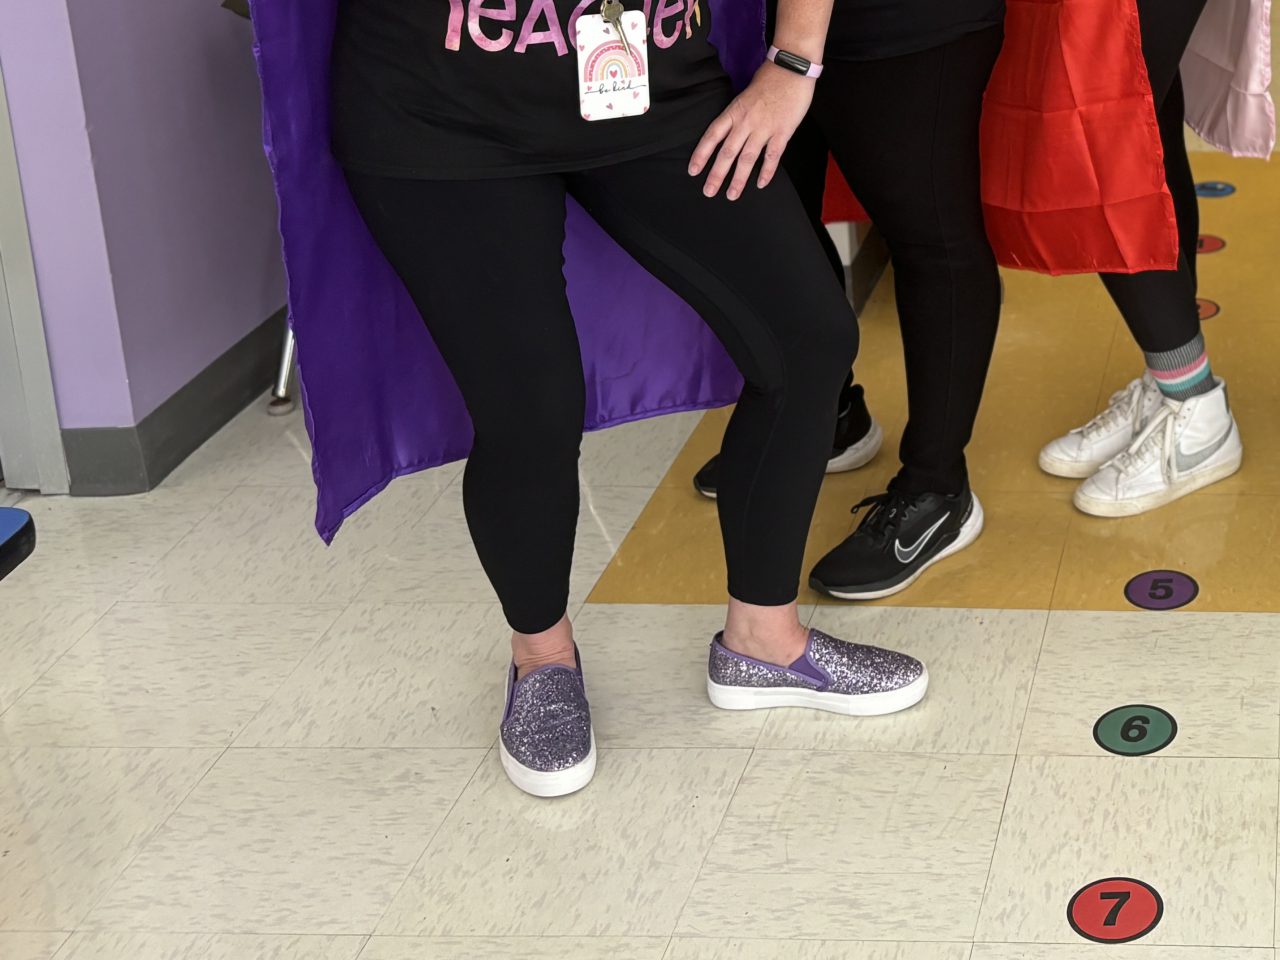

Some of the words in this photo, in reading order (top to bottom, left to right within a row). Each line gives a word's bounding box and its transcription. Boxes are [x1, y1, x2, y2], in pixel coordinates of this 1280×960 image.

[1147, 578, 1175, 601] 5
[1119, 714, 1151, 743] 6
[1099, 891, 1131, 927] 7
